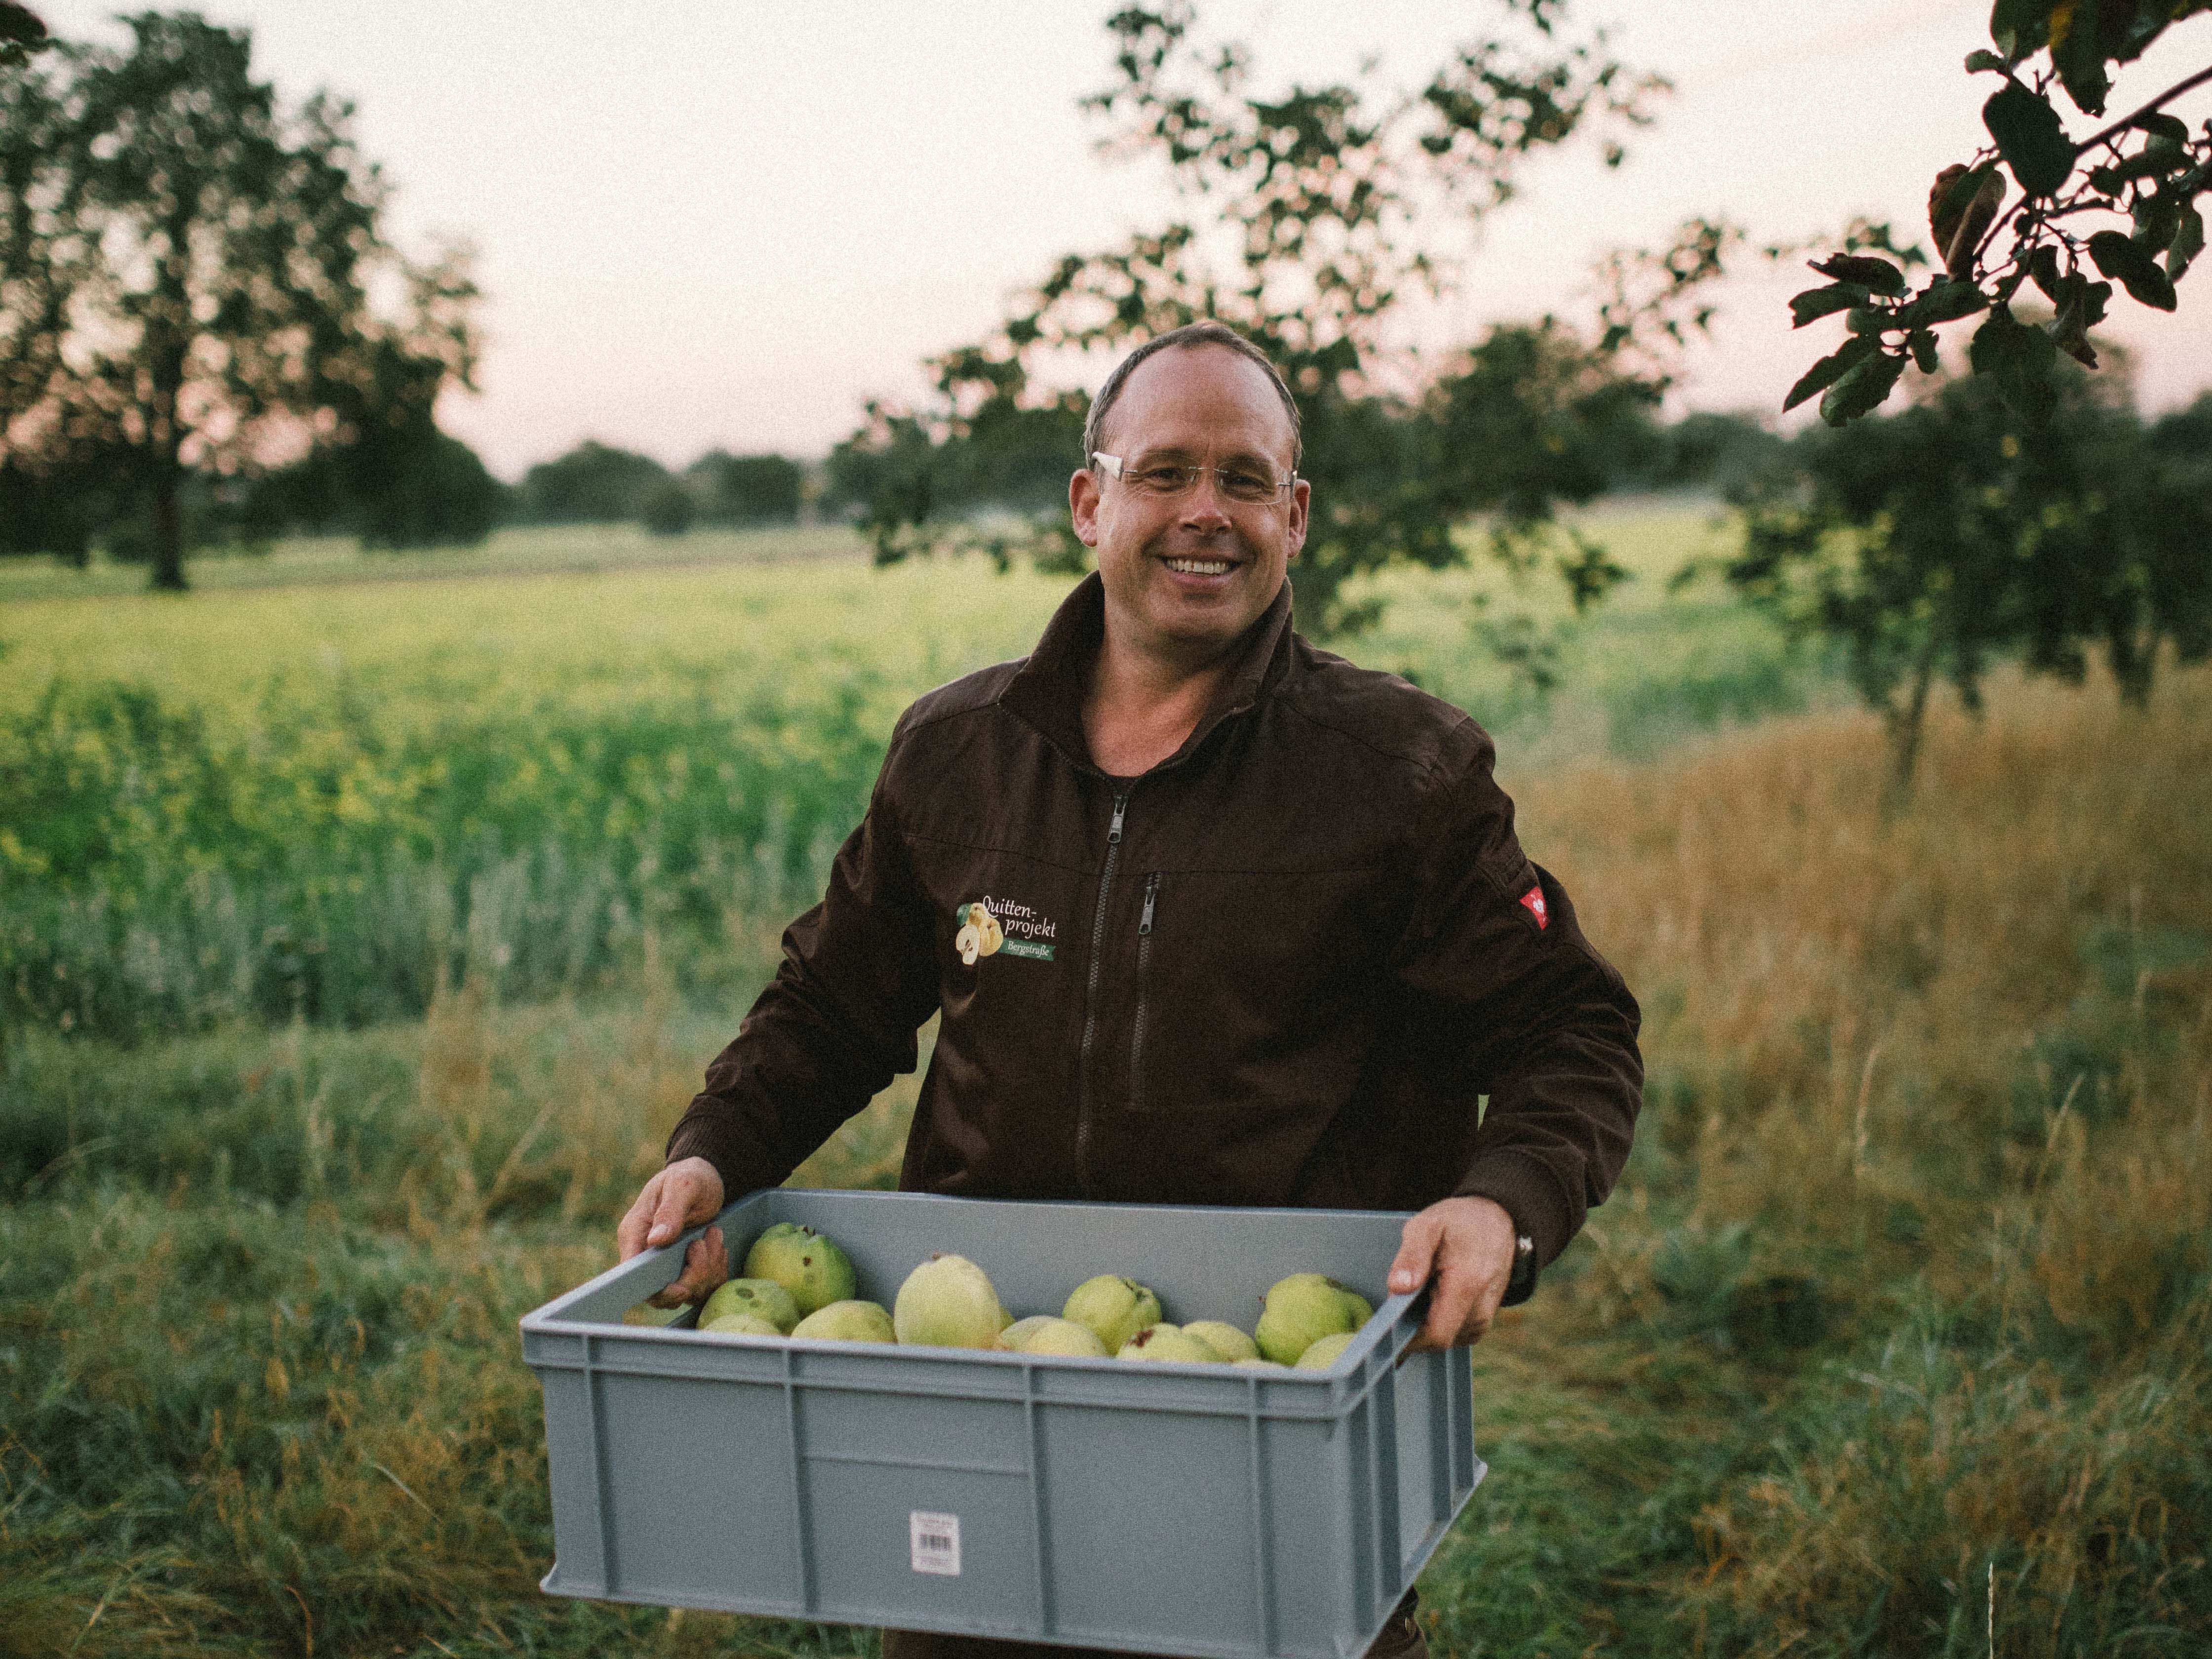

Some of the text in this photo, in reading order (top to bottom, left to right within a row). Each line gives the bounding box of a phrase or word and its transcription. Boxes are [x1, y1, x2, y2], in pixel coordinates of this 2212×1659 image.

[983, 895, 1037, 918] Quitten-
[1005, 917, 1056, 939] projekt
[1008, 941, 1050, 957] Bergstraße
